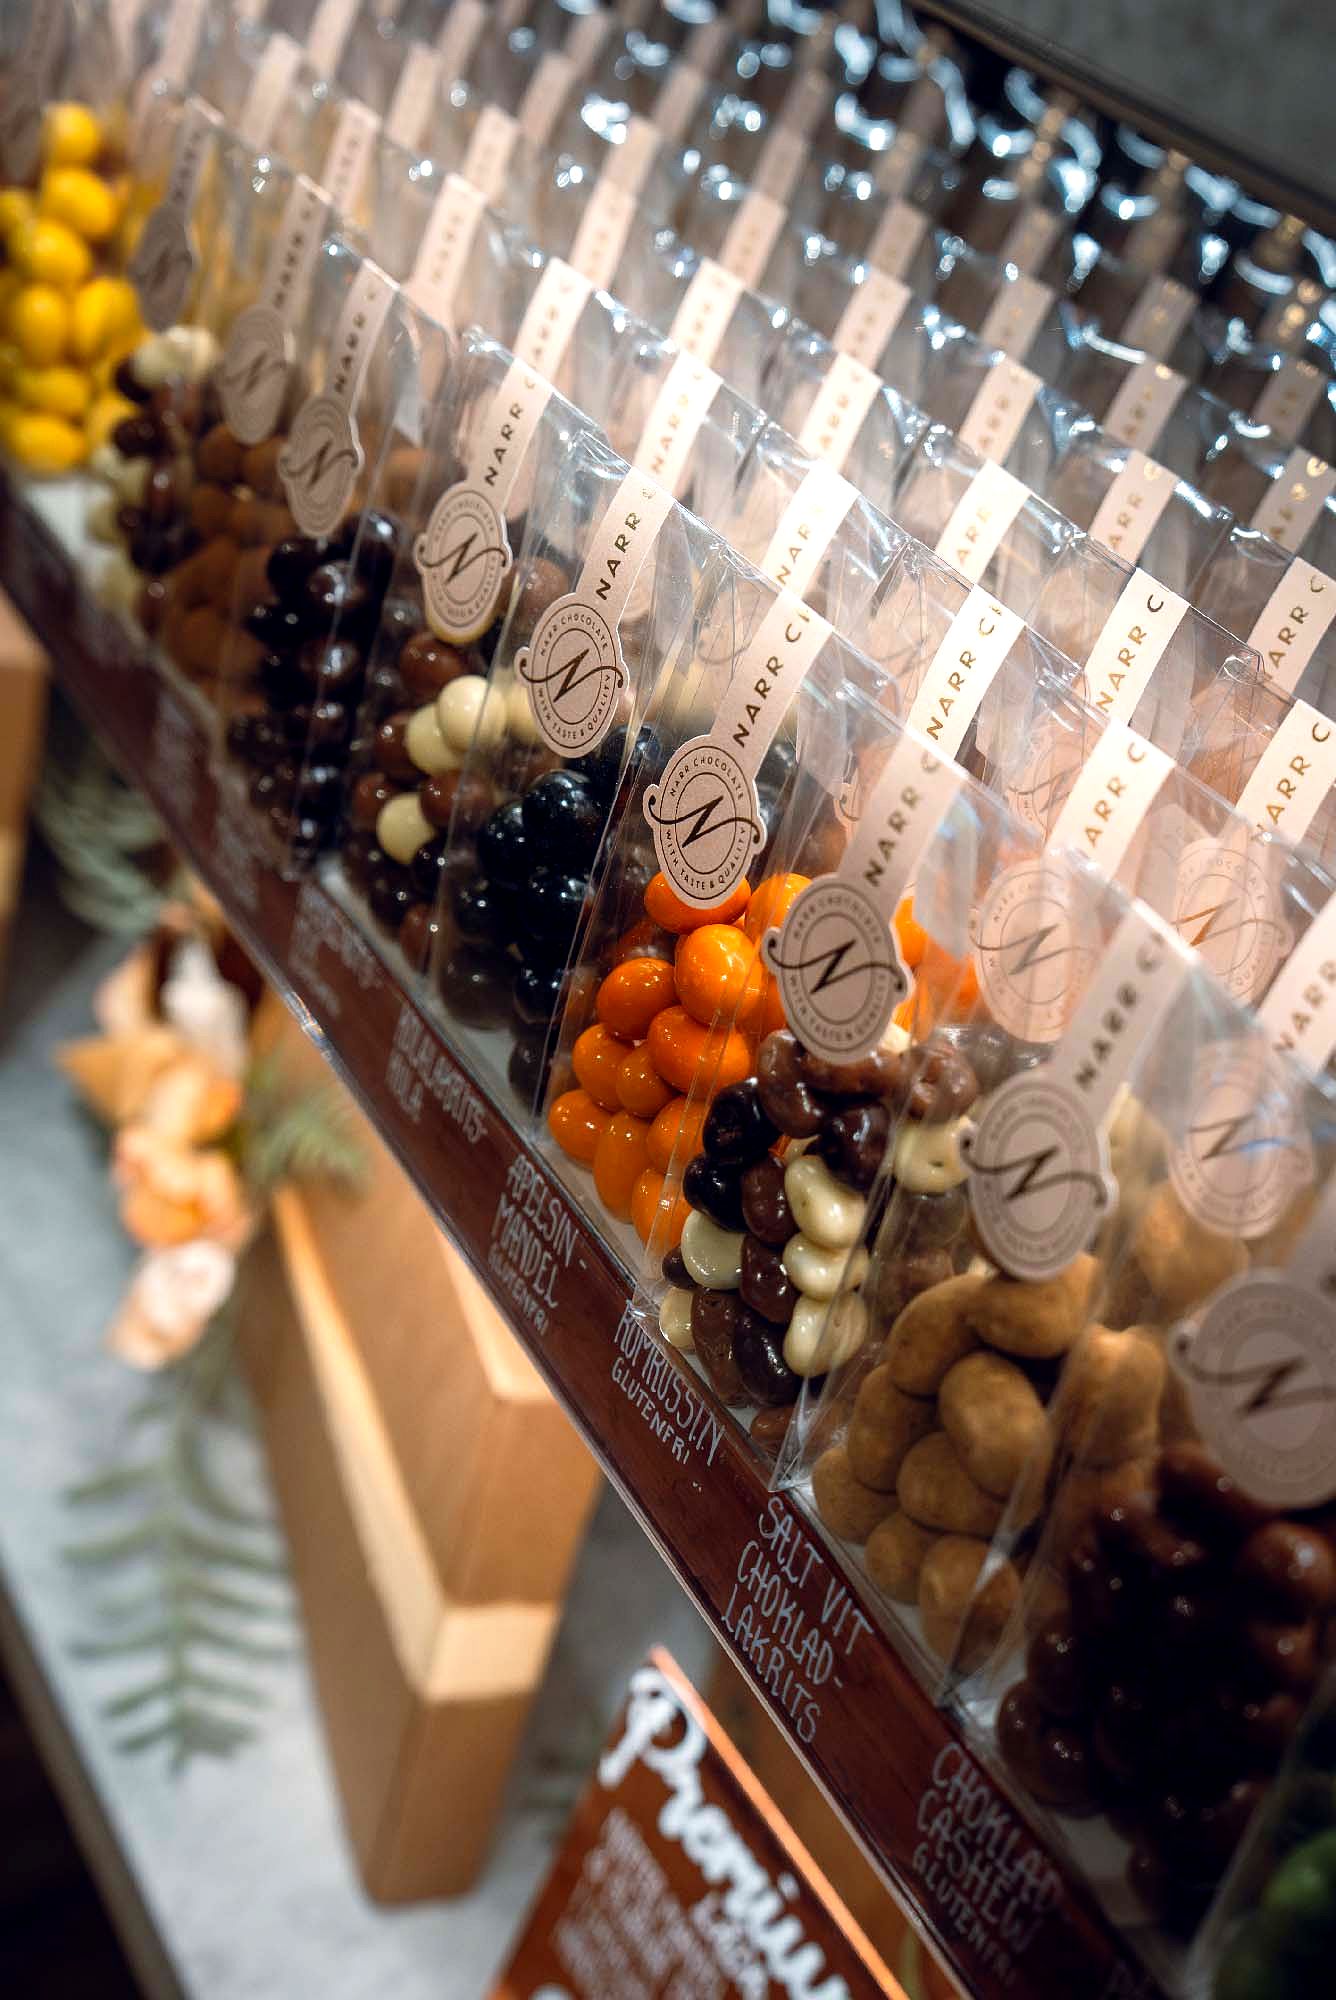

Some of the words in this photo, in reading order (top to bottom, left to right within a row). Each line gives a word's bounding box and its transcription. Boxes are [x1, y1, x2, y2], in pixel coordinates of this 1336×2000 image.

[484, 402, 523, 486] NARR
[595, 512, 641, 600] NARR
[561, 613, 608, 650] CHOCOLATE
[1096, 625, 1147, 713] NARR
[1265, 606, 1309, 678] ARR
[587, 673, 611, 732] QUALITY
[732, 655, 784, 748] NARR
[926, 650, 976, 741] NARR
[669, 765, 690, 798] NARR
[693, 756, 744, 800] CHOCOLATE
[1084, 775, 1129, 848] ARR
[666, 828, 679, 867] WITH
[680, 868, 706, 890] TASTE
[717, 827, 746, 884] QUALITY
[862, 785, 924, 887] NARR
[491, 1191, 558, 1309] MANDEL
[611, 1357, 690, 1465] GLUTENFRI
[759, 1496, 824, 1588] SALT
[821, 1577, 874, 1655] VIT
[721, 1583, 821, 1744] LAKRITS
